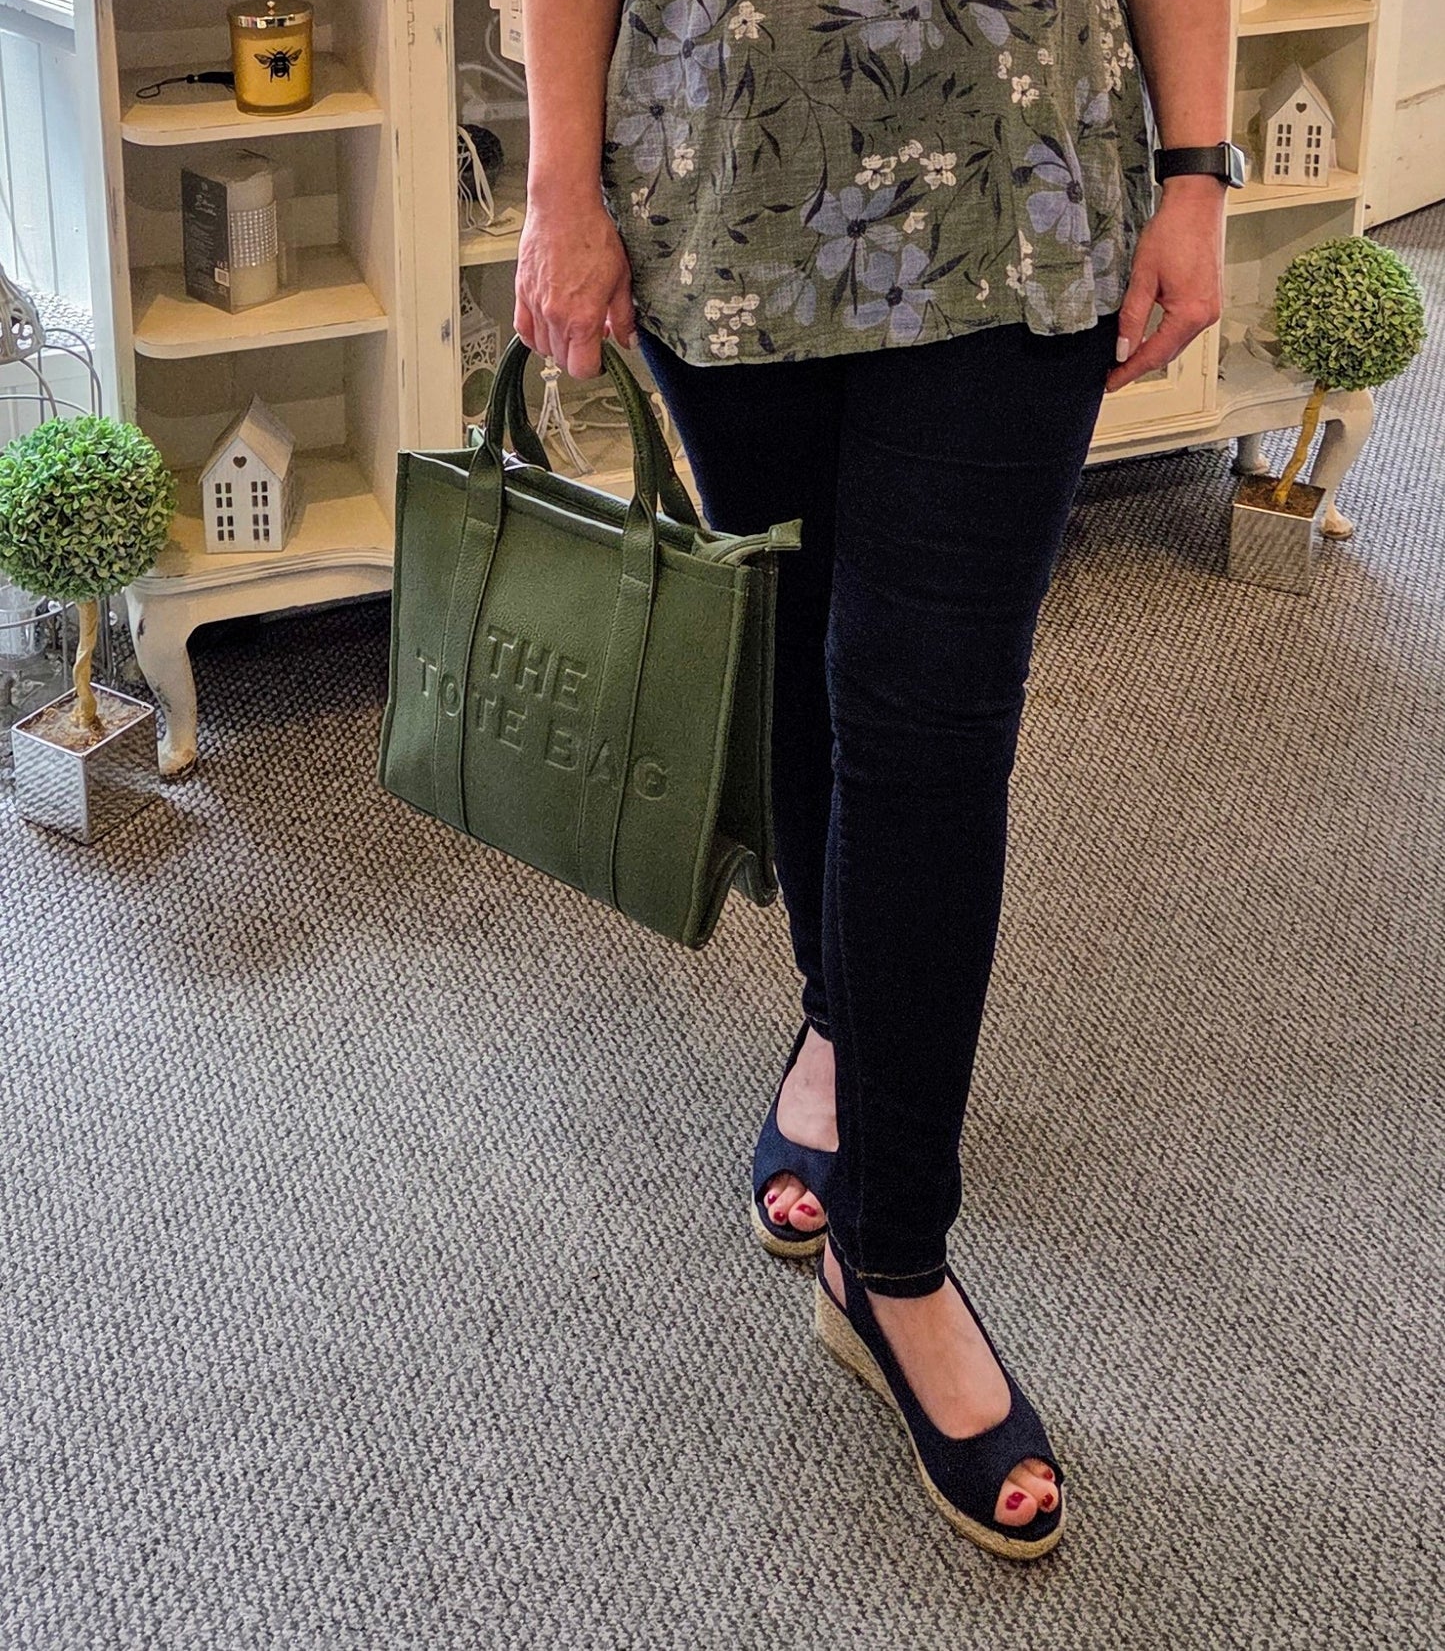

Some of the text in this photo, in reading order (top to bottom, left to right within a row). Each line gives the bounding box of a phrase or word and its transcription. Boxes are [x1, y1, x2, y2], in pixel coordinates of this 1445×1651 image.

[415, 647, 672, 801] TOTE BAG
[487, 624, 589, 712] THE
